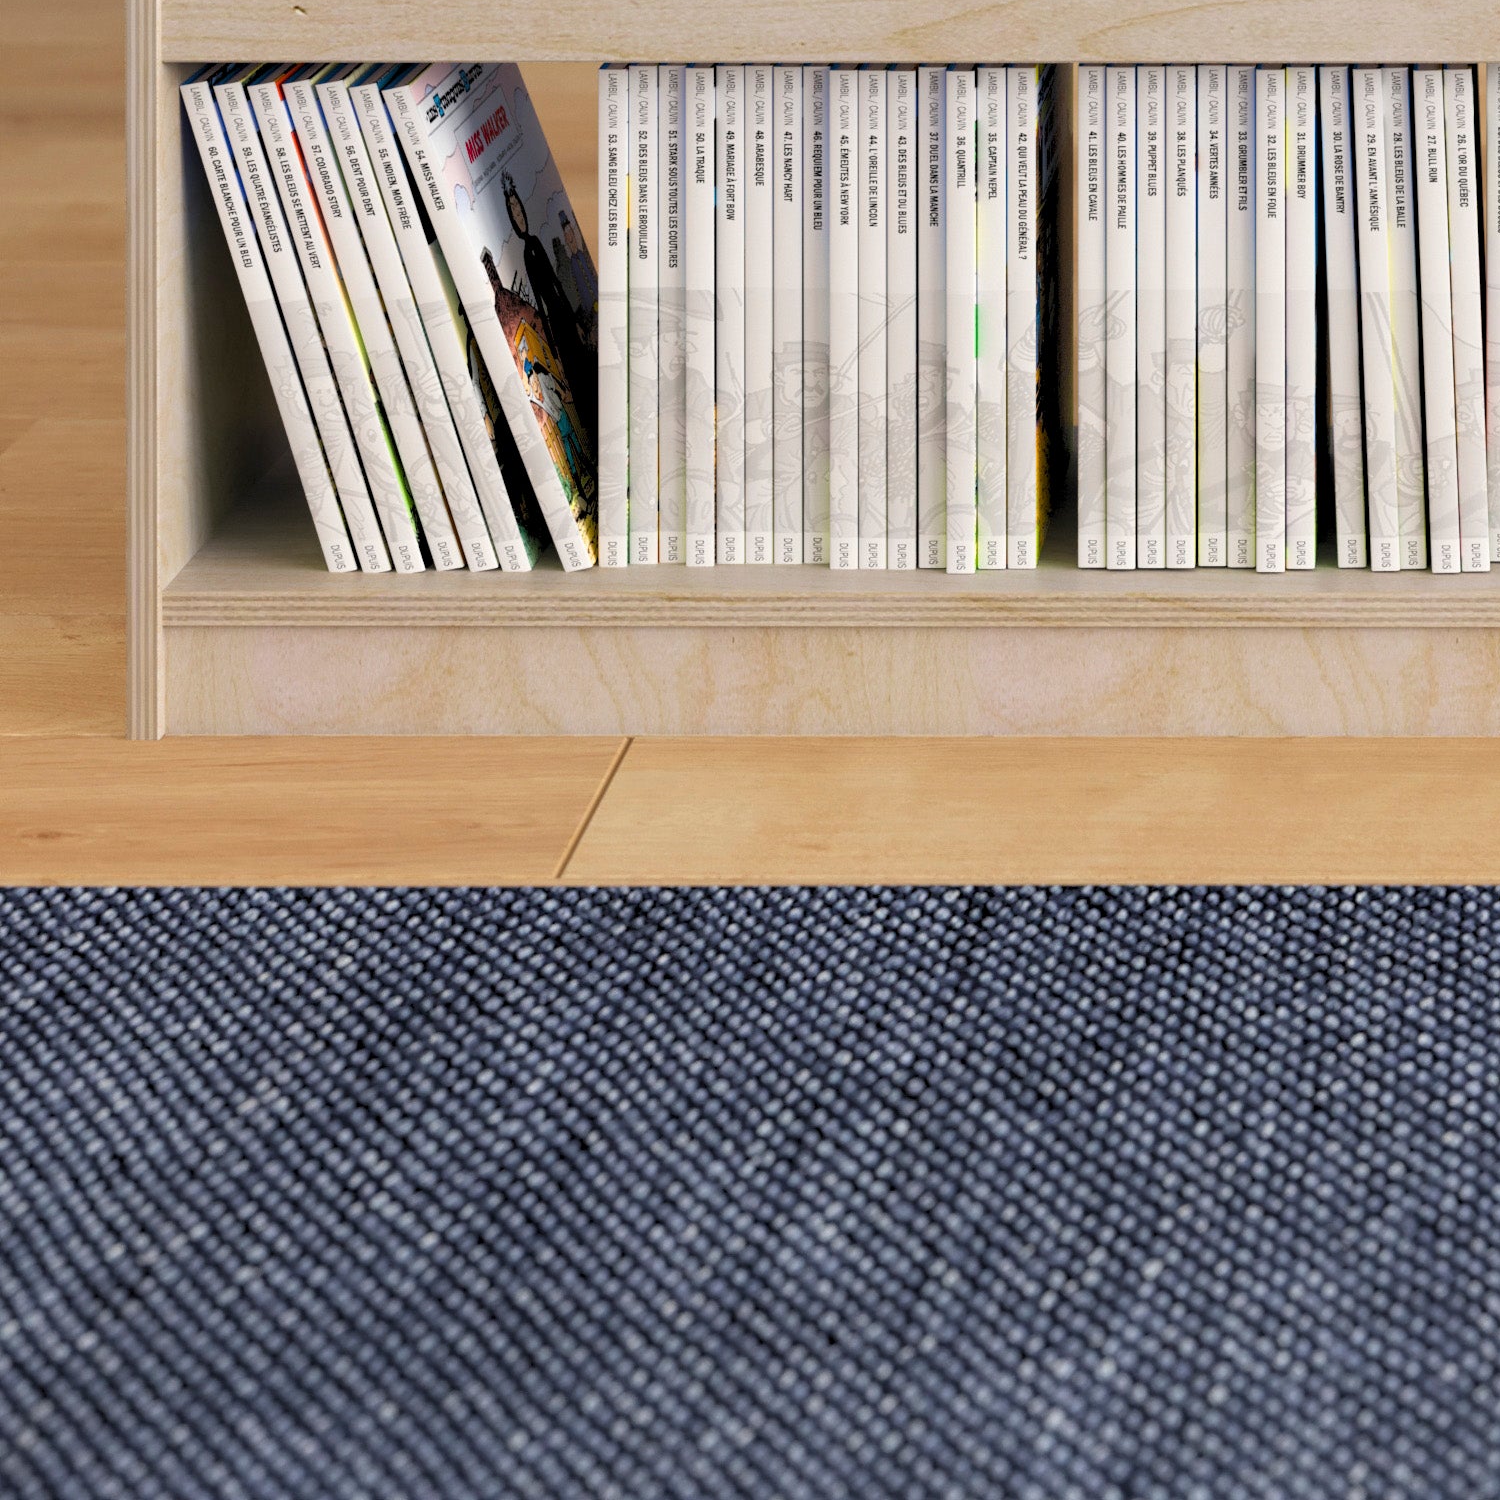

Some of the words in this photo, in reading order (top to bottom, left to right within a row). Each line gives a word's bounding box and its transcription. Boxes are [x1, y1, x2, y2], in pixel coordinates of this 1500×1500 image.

[607, 73, 619, 98] LAMBIL
[1017, 71, 1028, 96] LAMBIL
[189, 86, 206, 112] LAMBIL
[392, 90, 409, 117] LAMBIL
[607, 104, 619, 129] CAUVIN
[1017, 102, 1028, 127] CAUVIN
[199, 117, 215, 142] CAUVIN
[403, 121, 421, 146] CAUVIN
[465, 133, 485, 164] MISS
[481, 105, 509, 146] WALKER
[725, 130, 736, 143] 49.
[783, 131, 793, 142] 47.
[928, 131, 939, 143] 37.
[1018, 132, 1028, 145] 42.
[1088, 130, 1098, 143] 41.
[1208, 130, 1219, 142] 34.
[1296, 132, 1307, 144] 31.
[1332, 131, 1343, 144] 30.
[607, 134, 618, 146] 53.
[839, 134, 849, 147] 45.
[1333, 144, 1343, 154] LA
[1456, 134, 1467, 146] 26.
[207, 146, 219, 159] 60.
[241, 146, 253, 159] 59.
[275, 147, 287, 160] 58.
[310, 144, 323, 156] 57.
[344, 145, 356, 158] 56.
[377, 148, 389, 161] 55.
[414, 149, 426, 163] 54.
[607, 147, 618, 167] SANG
[783, 143, 793, 157] LES
[928, 144, 940, 164] DUEL
[1016, 145, 1028, 159] QUI
[1088, 144, 1098, 157] LES
[1208, 142, 1219, 170] VERTES
[245, 159, 258, 173] LES
[279, 159, 292, 174] LES
[349, 158, 364, 176] DENT
[725, 143, 736, 177] MARIAGE
[839, 148, 852, 182] ÉMEUTES
[1017, 159, 1028, 178] VEUT
[1296, 145, 1306, 183] DRUMMER
[1333, 154, 1344, 174] ROSE
[211, 159, 227, 182] CARTE
[314, 156, 335, 195] COLORADO
[419, 162, 434, 182] MISS
[608, 168, 618, 187] BLEU
[783, 158, 793, 182] NANCY
[928, 164, 939, 184] DANS
[1088, 158, 1098, 182] BLEUS
[1457, 166, 1468, 177] DU
[249, 173, 268, 202] QUATRE
[283, 173, 299, 198] BLEUS
[355, 177, 370, 198] POUR
[1018, 179, 1028, 189] LA
[1088, 183, 1098, 193] EN
[1209, 170, 1221, 199] ANNÉES
[1334, 175, 1345, 185] DE
[219, 182, 238, 217] BLANCHE
[391, 188, 404, 206] MON
[427, 181, 446, 211] WALKER
[608, 188, 618, 208] CHEZ
[725, 184, 736, 203] FORT
[783, 183, 793, 202] HART
[840, 189, 850, 206] NEW
[929, 185, 939, 195] LA
[1017, 189, 1028, 208] PEAU
[1296, 184, 1307, 199] BOY
[1457, 178, 1470, 208] QUÉBEC
[291, 198, 303, 209] SE
[327, 195, 343, 218] STORY
[361, 198, 376, 216] DENT
[1088, 194, 1098, 221] CAVALE
[1335, 186, 1345, 214] BANTRY
[396, 206, 412, 230] FRÈRE
[608, 208, 618, 222] LES
[725, 203, 736, 221] BOW
[839, 206, 850, 226] YORK
[929, 195, 939, 227] MANCHE
[1017, 209, 1028, 220] DU
[229, 216, 244, 238] POUR
[259, 201, 283, 253] ÉVANGÉLISTES
[294, 208, 313, 240] METTENT
[235, 237, 247, 249] UN
[608, 223, 618, 247] BLEUS
[1018, 221, 1030, 254] GÉNÉRAL
[304, 240, 316, 251] AU
[239, 249, 254, 268] BLEU
[307, 251, 322, 269] VERT
[330, 544, 346, 570] DUPUIS
[564, 543, 582, 569] DUPUIS
[608, 541, 618, 567] DUPUIS
[1017, 540, 1027, 566] DUPUIS
